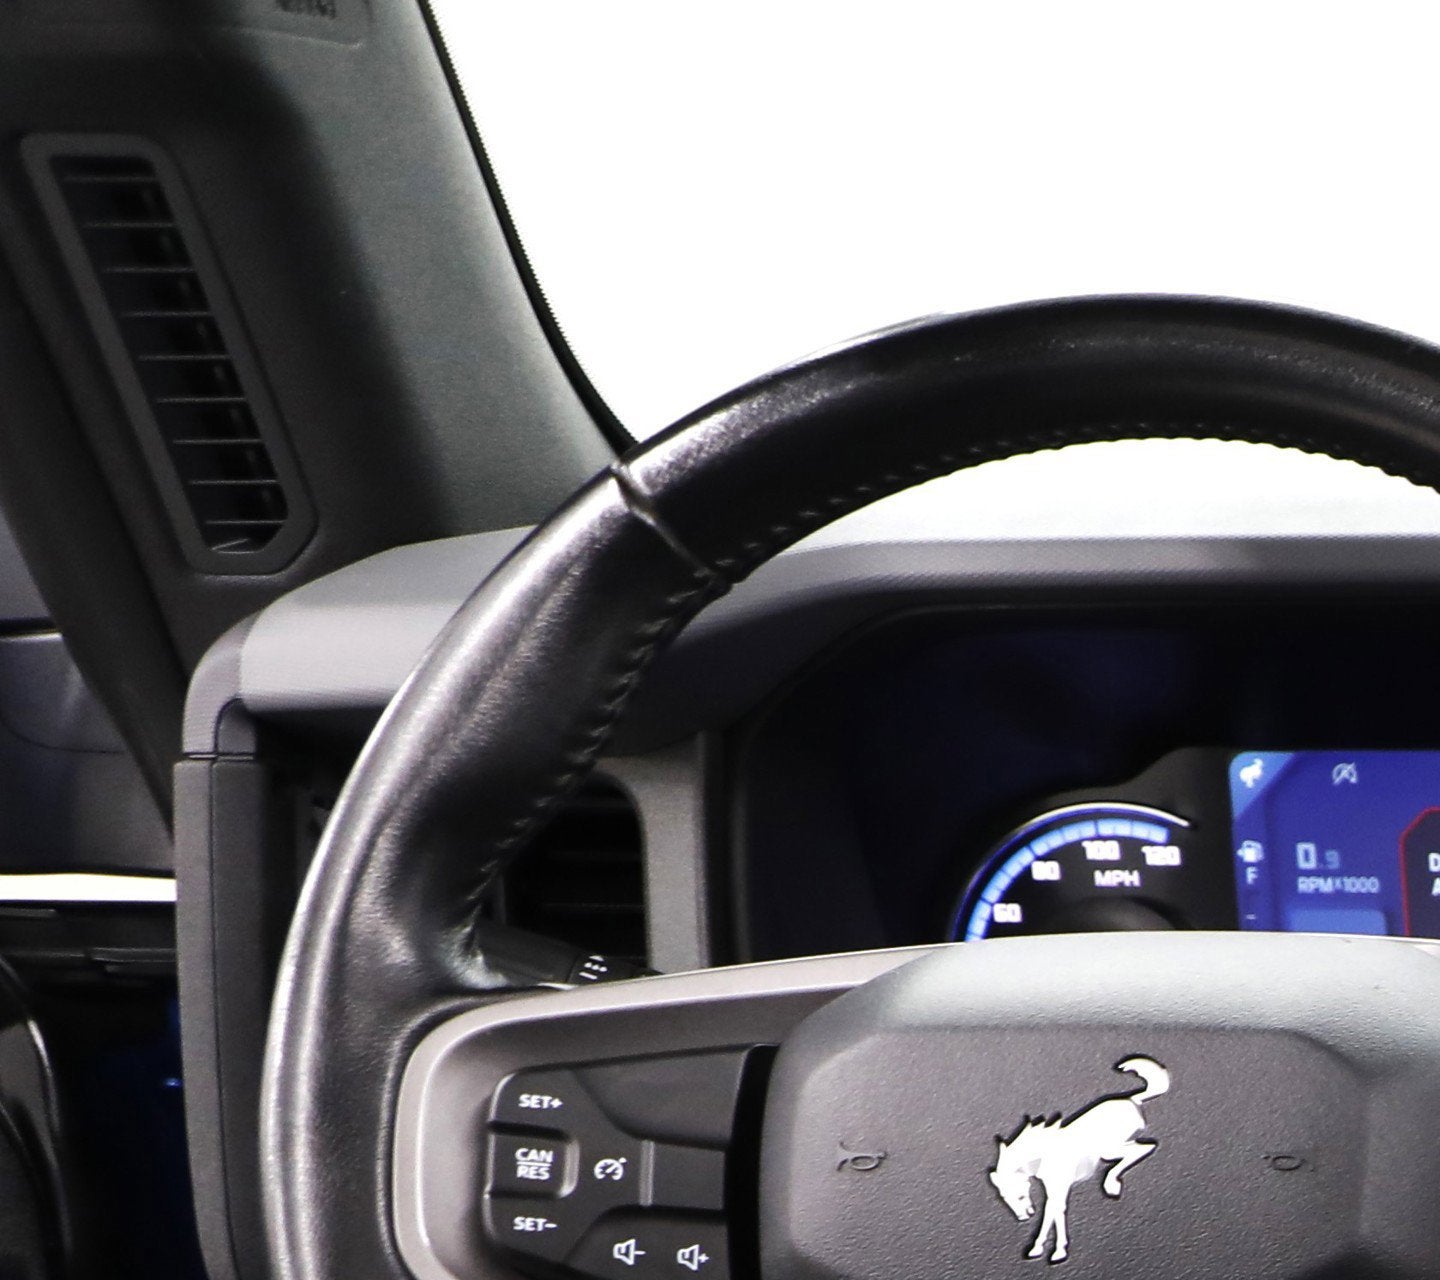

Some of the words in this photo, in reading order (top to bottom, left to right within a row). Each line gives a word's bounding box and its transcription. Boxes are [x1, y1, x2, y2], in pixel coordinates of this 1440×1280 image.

[1093, 868, 1142, 888] MPH
[1244, 864, 1258, 886] F
[515, 1147, 553, 1162] CAN
[516, 1165, 550, 1180] RES
